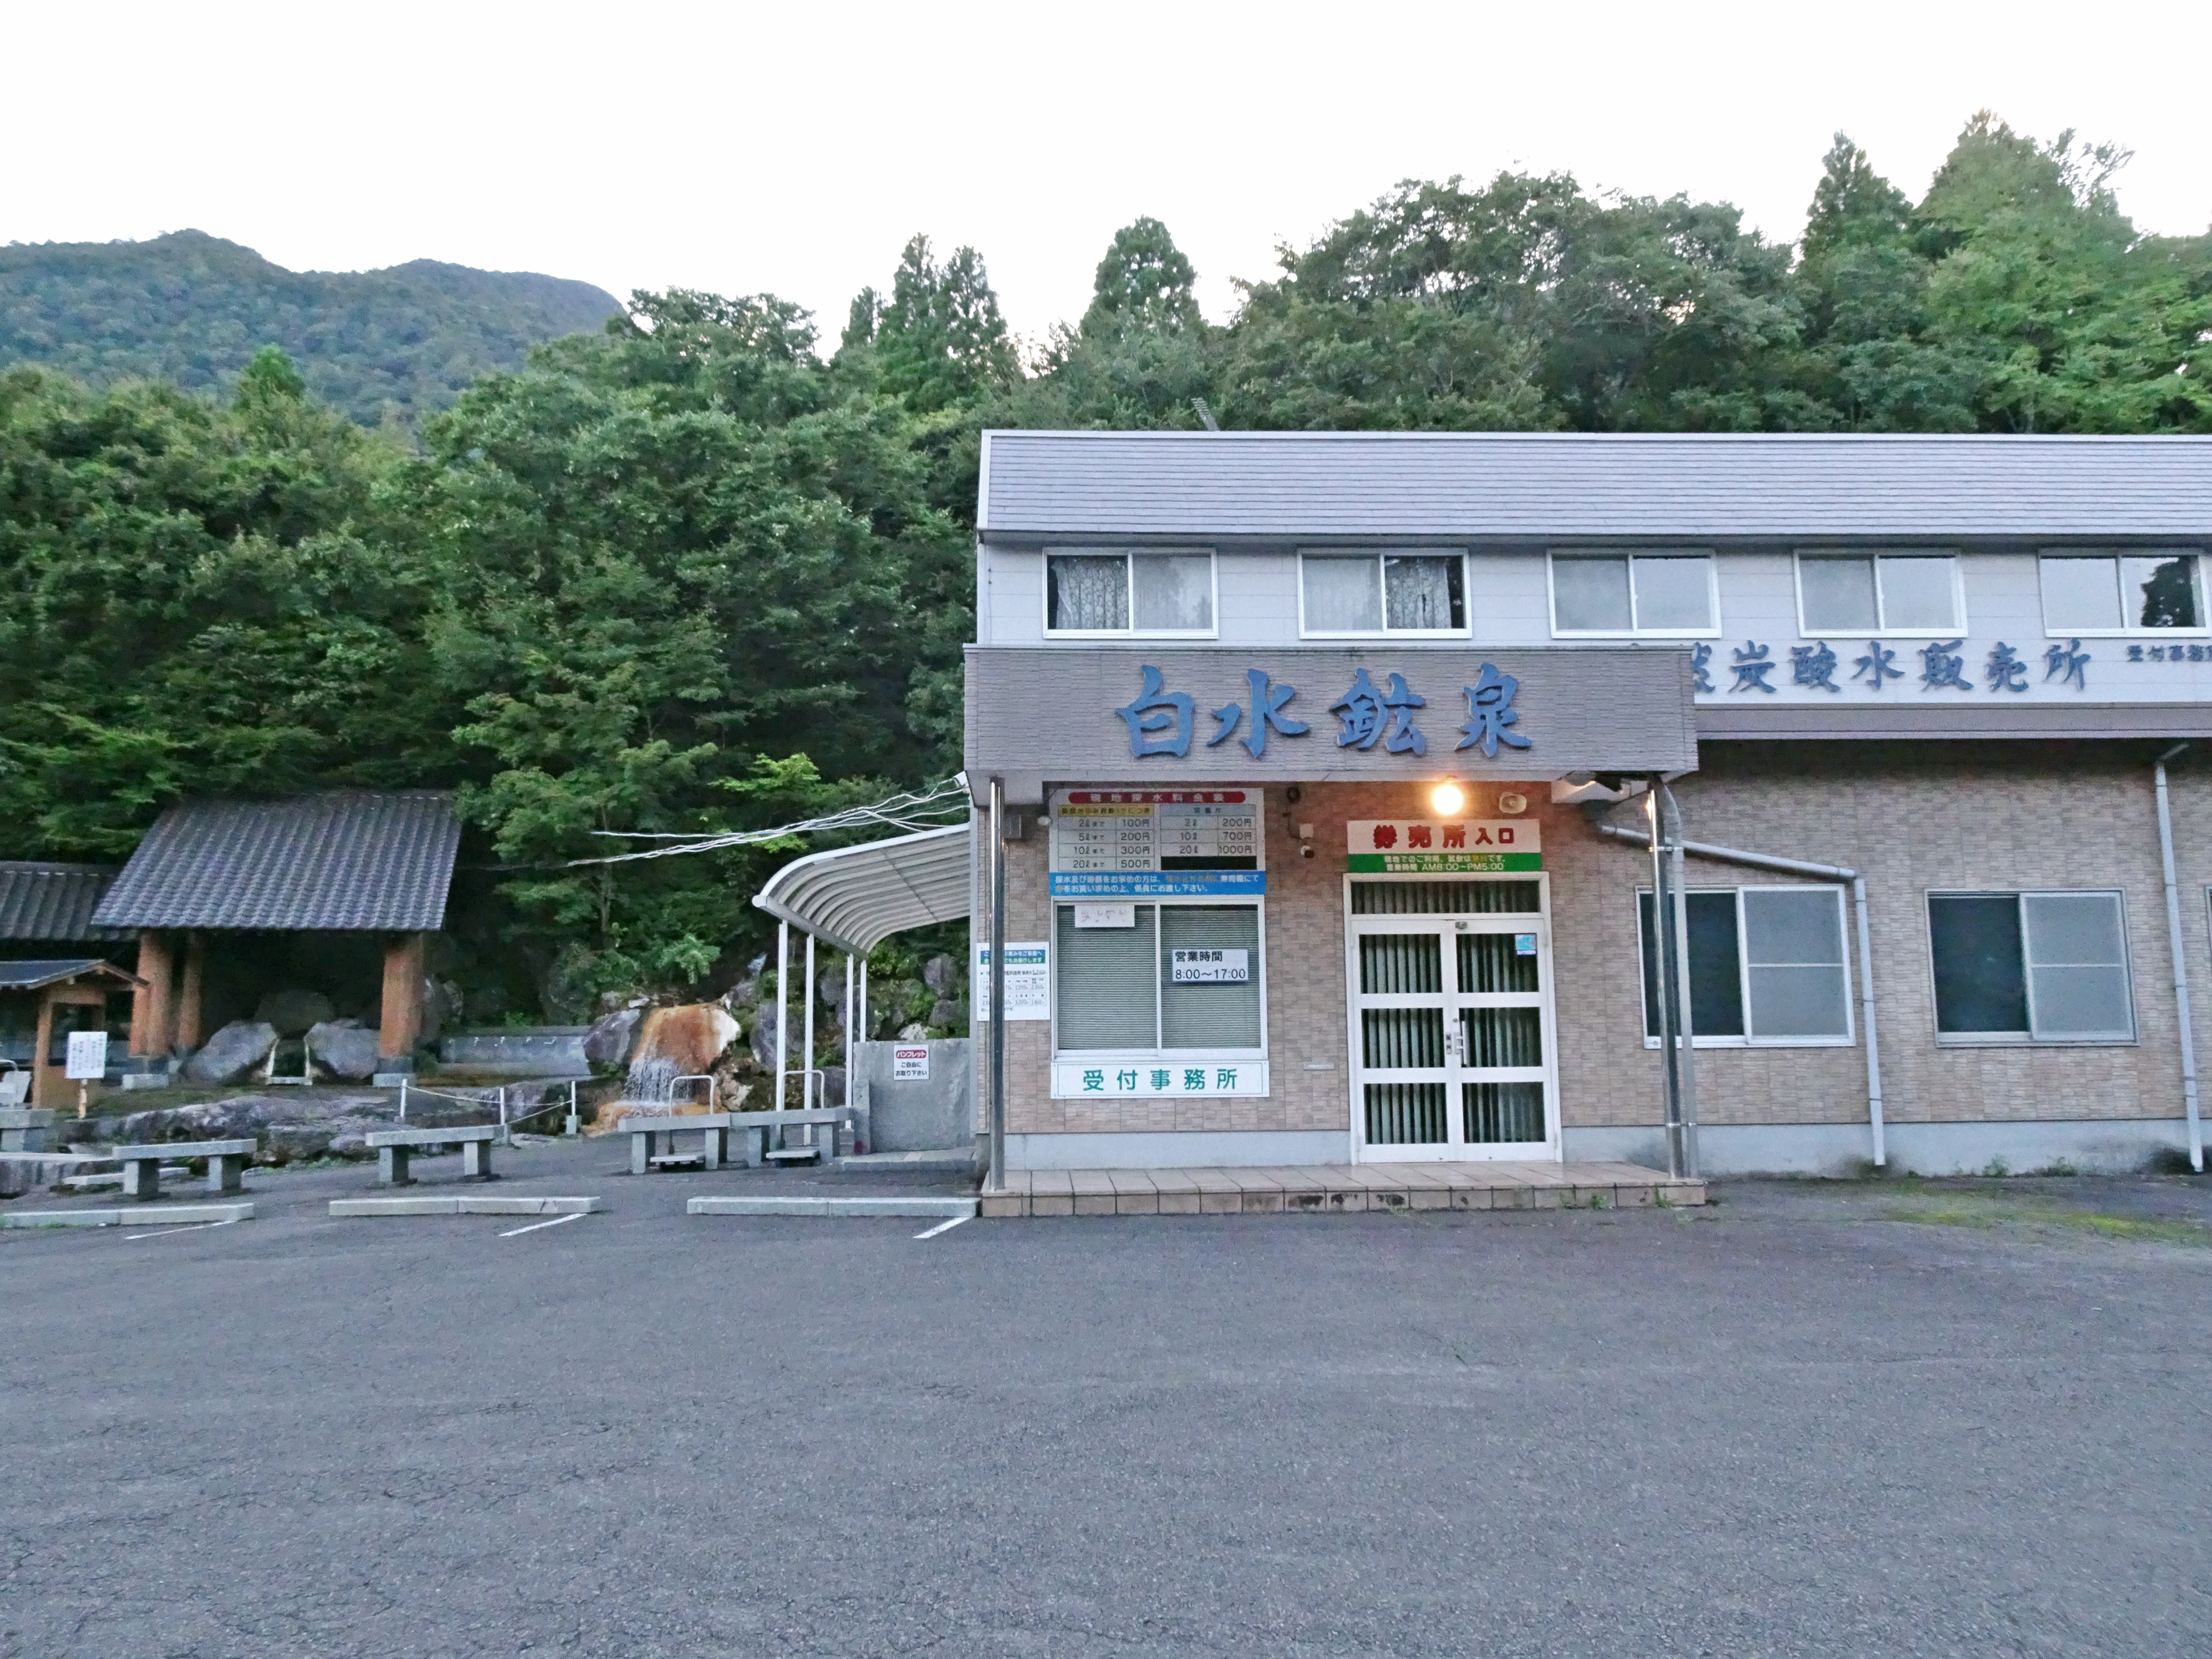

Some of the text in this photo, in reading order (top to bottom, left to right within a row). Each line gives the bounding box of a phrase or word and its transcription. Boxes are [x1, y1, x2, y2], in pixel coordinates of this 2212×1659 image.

[1117, 662, 1532, 758] 白水鉱泉
[1122, 819, 1150, 827] 100円
[1222, 818, 1251, 827] 200円
[1120, 832, 1150, 841] 200円
[1223, 832, 1251, 840] 700円
[1373, 825, 1514, 849] 券売所入口
[1120, 846, 1150, 854] 300円
[1218, 845, 1252, 854] 1000円
[1120, 859, 1150, 868] 500円
[1175, 951, 1223, 962] 営業時間
[1083, 1069, 1238, 1091] 受付事務所
